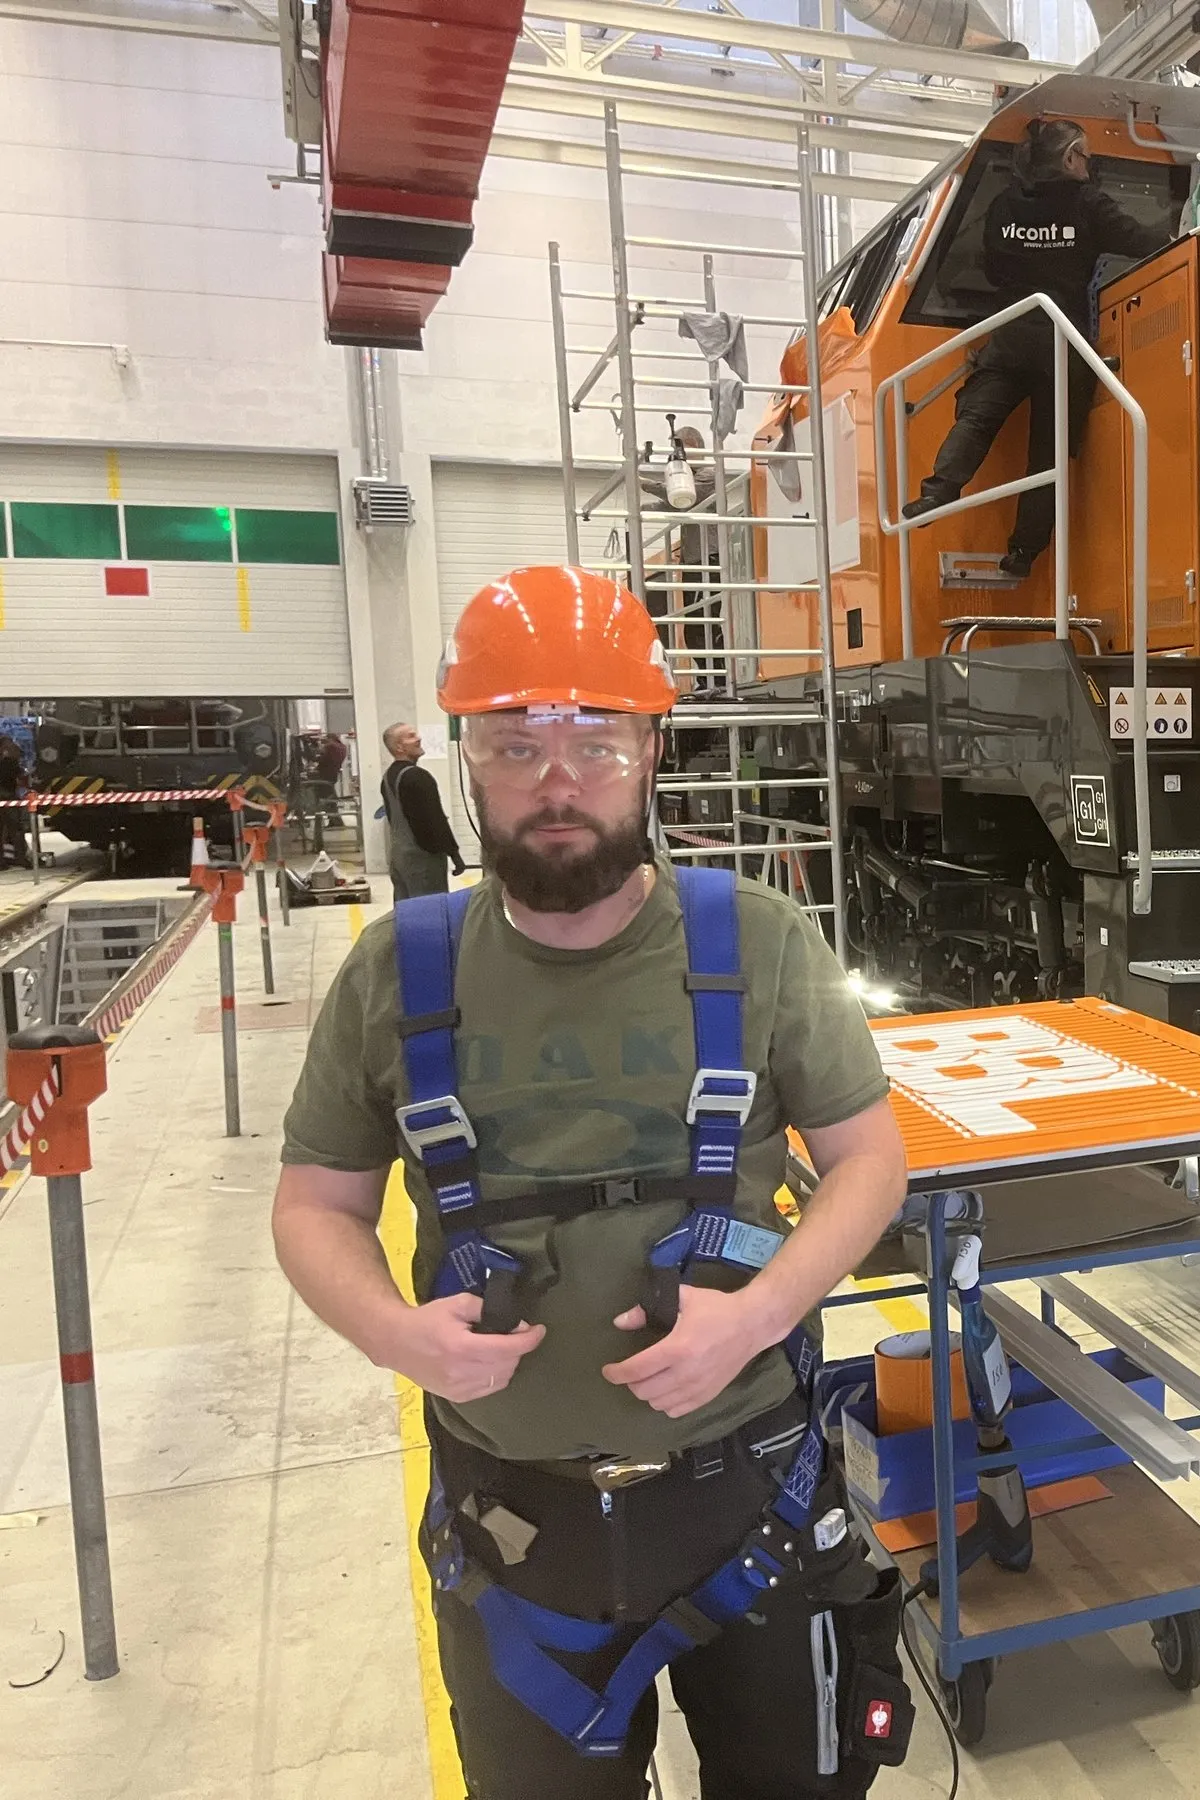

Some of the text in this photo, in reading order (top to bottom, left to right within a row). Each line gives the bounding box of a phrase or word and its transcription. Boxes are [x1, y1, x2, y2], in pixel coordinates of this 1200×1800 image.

[1002, 223, 1058, 241] vicont
[1095, 791, 1104, 804] G1
[1080, 800, 1093, 820] G1
